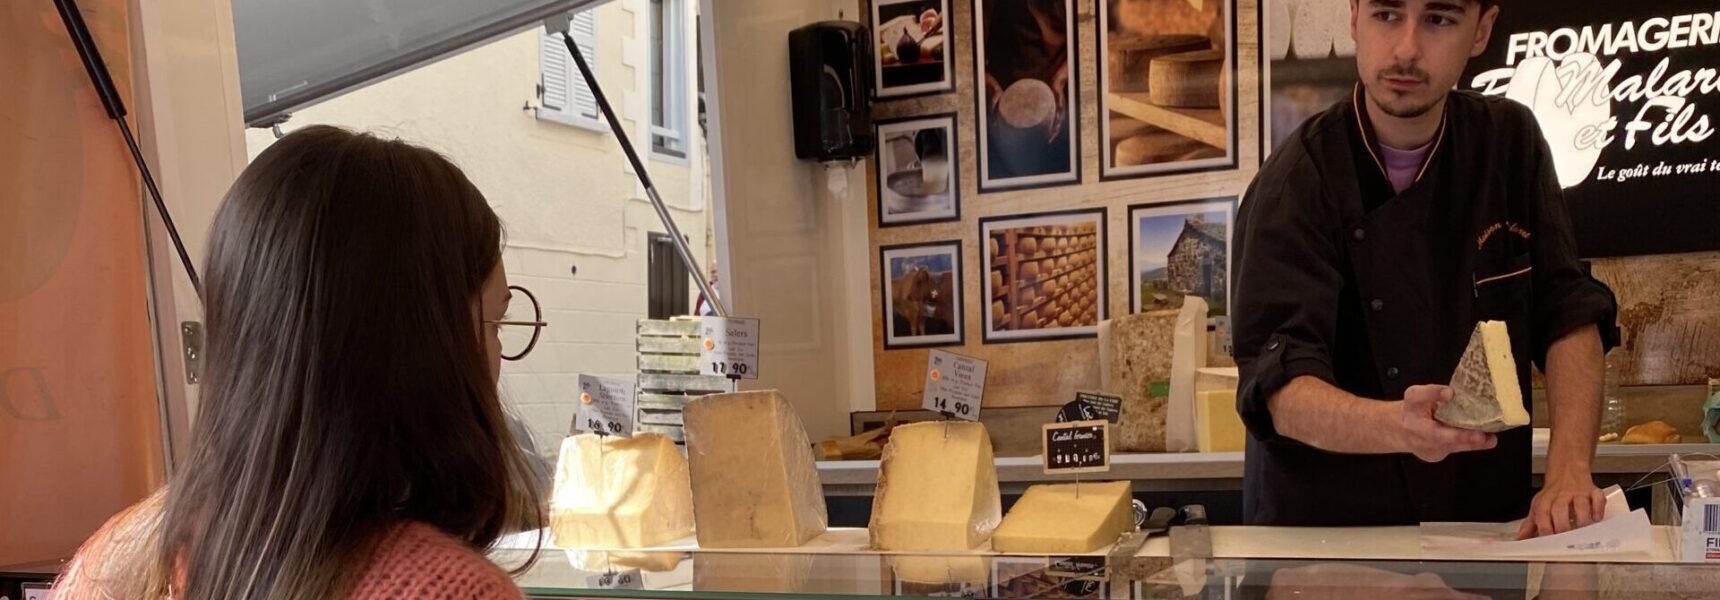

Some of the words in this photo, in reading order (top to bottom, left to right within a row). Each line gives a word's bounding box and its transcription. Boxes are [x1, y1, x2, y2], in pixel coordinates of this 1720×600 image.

[1506, 11, 1720, 66] FROMAGERI
[1554, 56, 1720, 108] Malar
[1573, 115, 1618, 150] et
[1624, 96, 1715, 150] Fils
[1597, 165, 1616, 180] Le
[1617, 163, 1650, 182] goût
[1652, 161, 1672, 176] du
[1676, 158, 1708, 174] vrai
[732, 362, 747, 374] 90
[934, 396, 946, 409] 14
[955, 402, 969, 415] 90
[608, 421, 622, 433] 90
